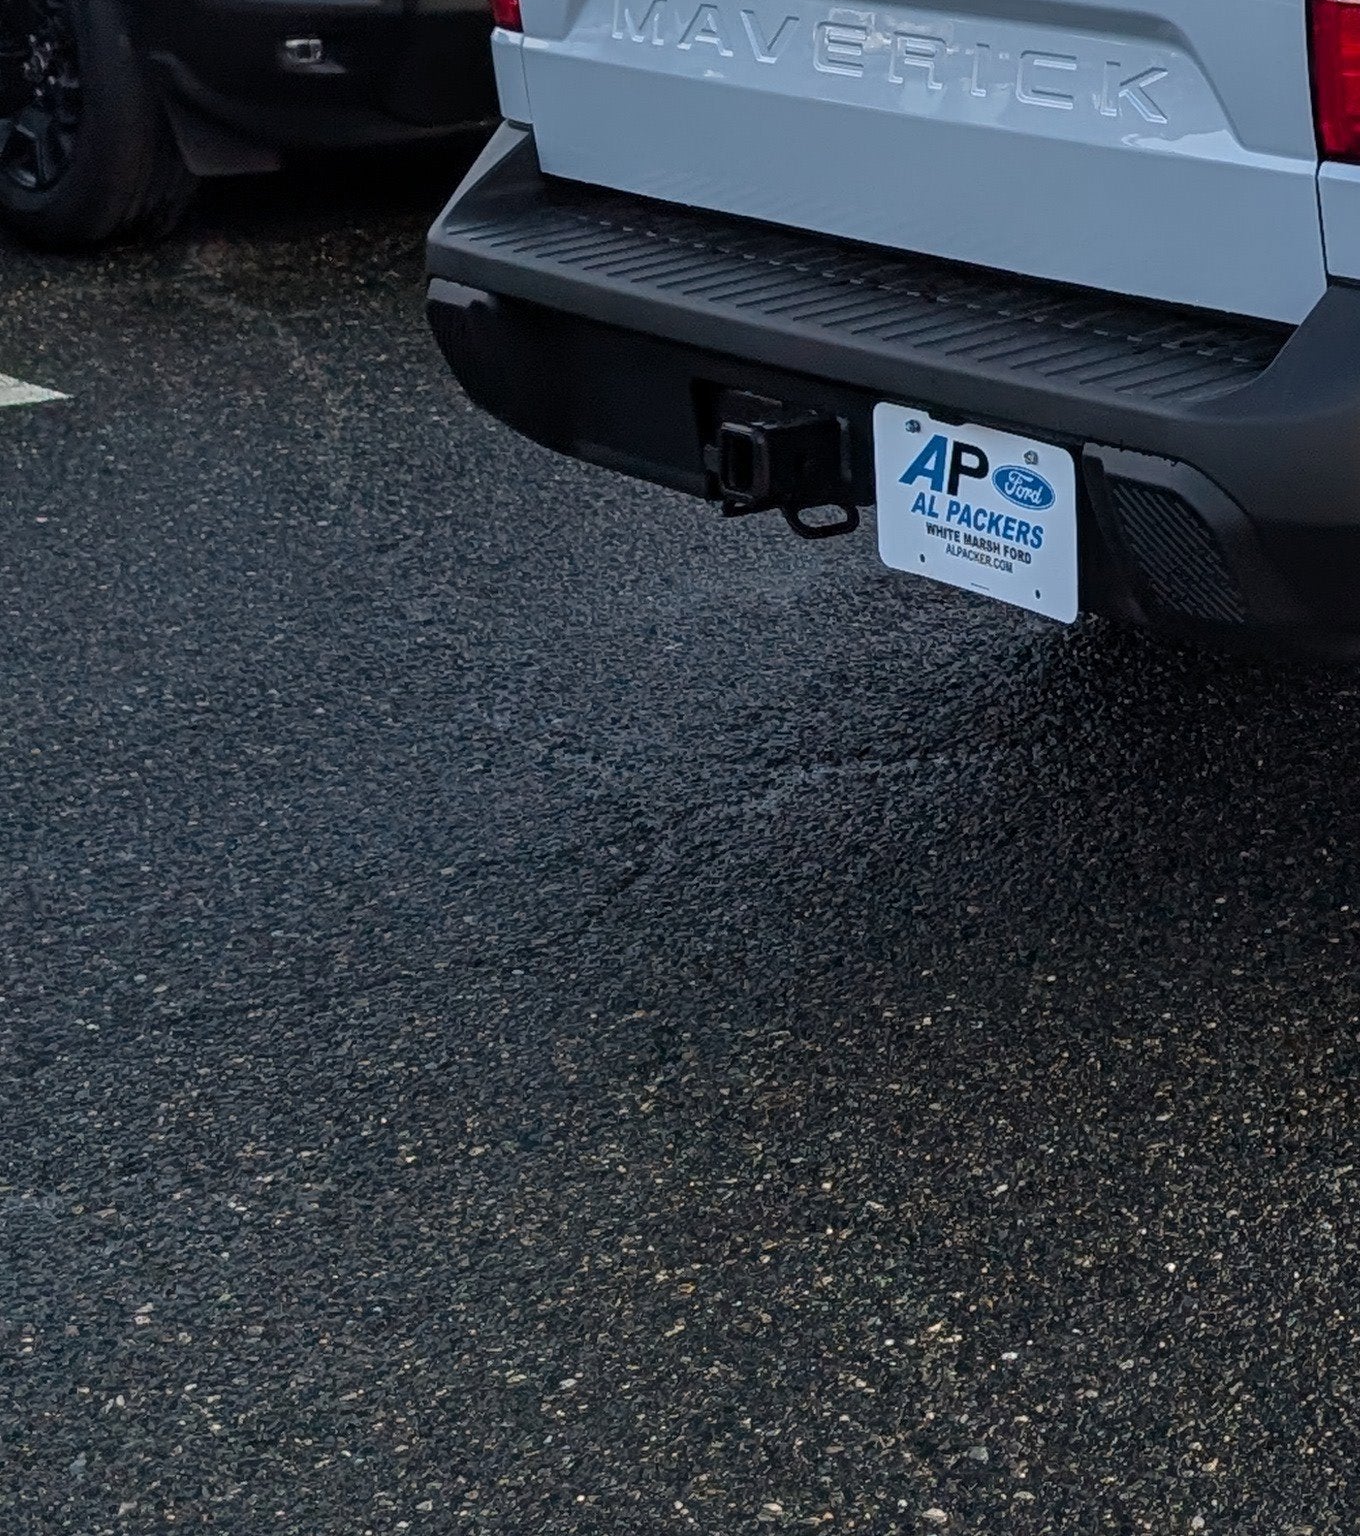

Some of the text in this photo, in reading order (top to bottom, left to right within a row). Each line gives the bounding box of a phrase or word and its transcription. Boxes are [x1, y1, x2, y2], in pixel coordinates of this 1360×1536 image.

[898, 434, 1043, 505] AP Ford
[910, 492, 1045, 550] AL PACKERS
[925, 522, 1032, 565] WHITE MARSH FORD
